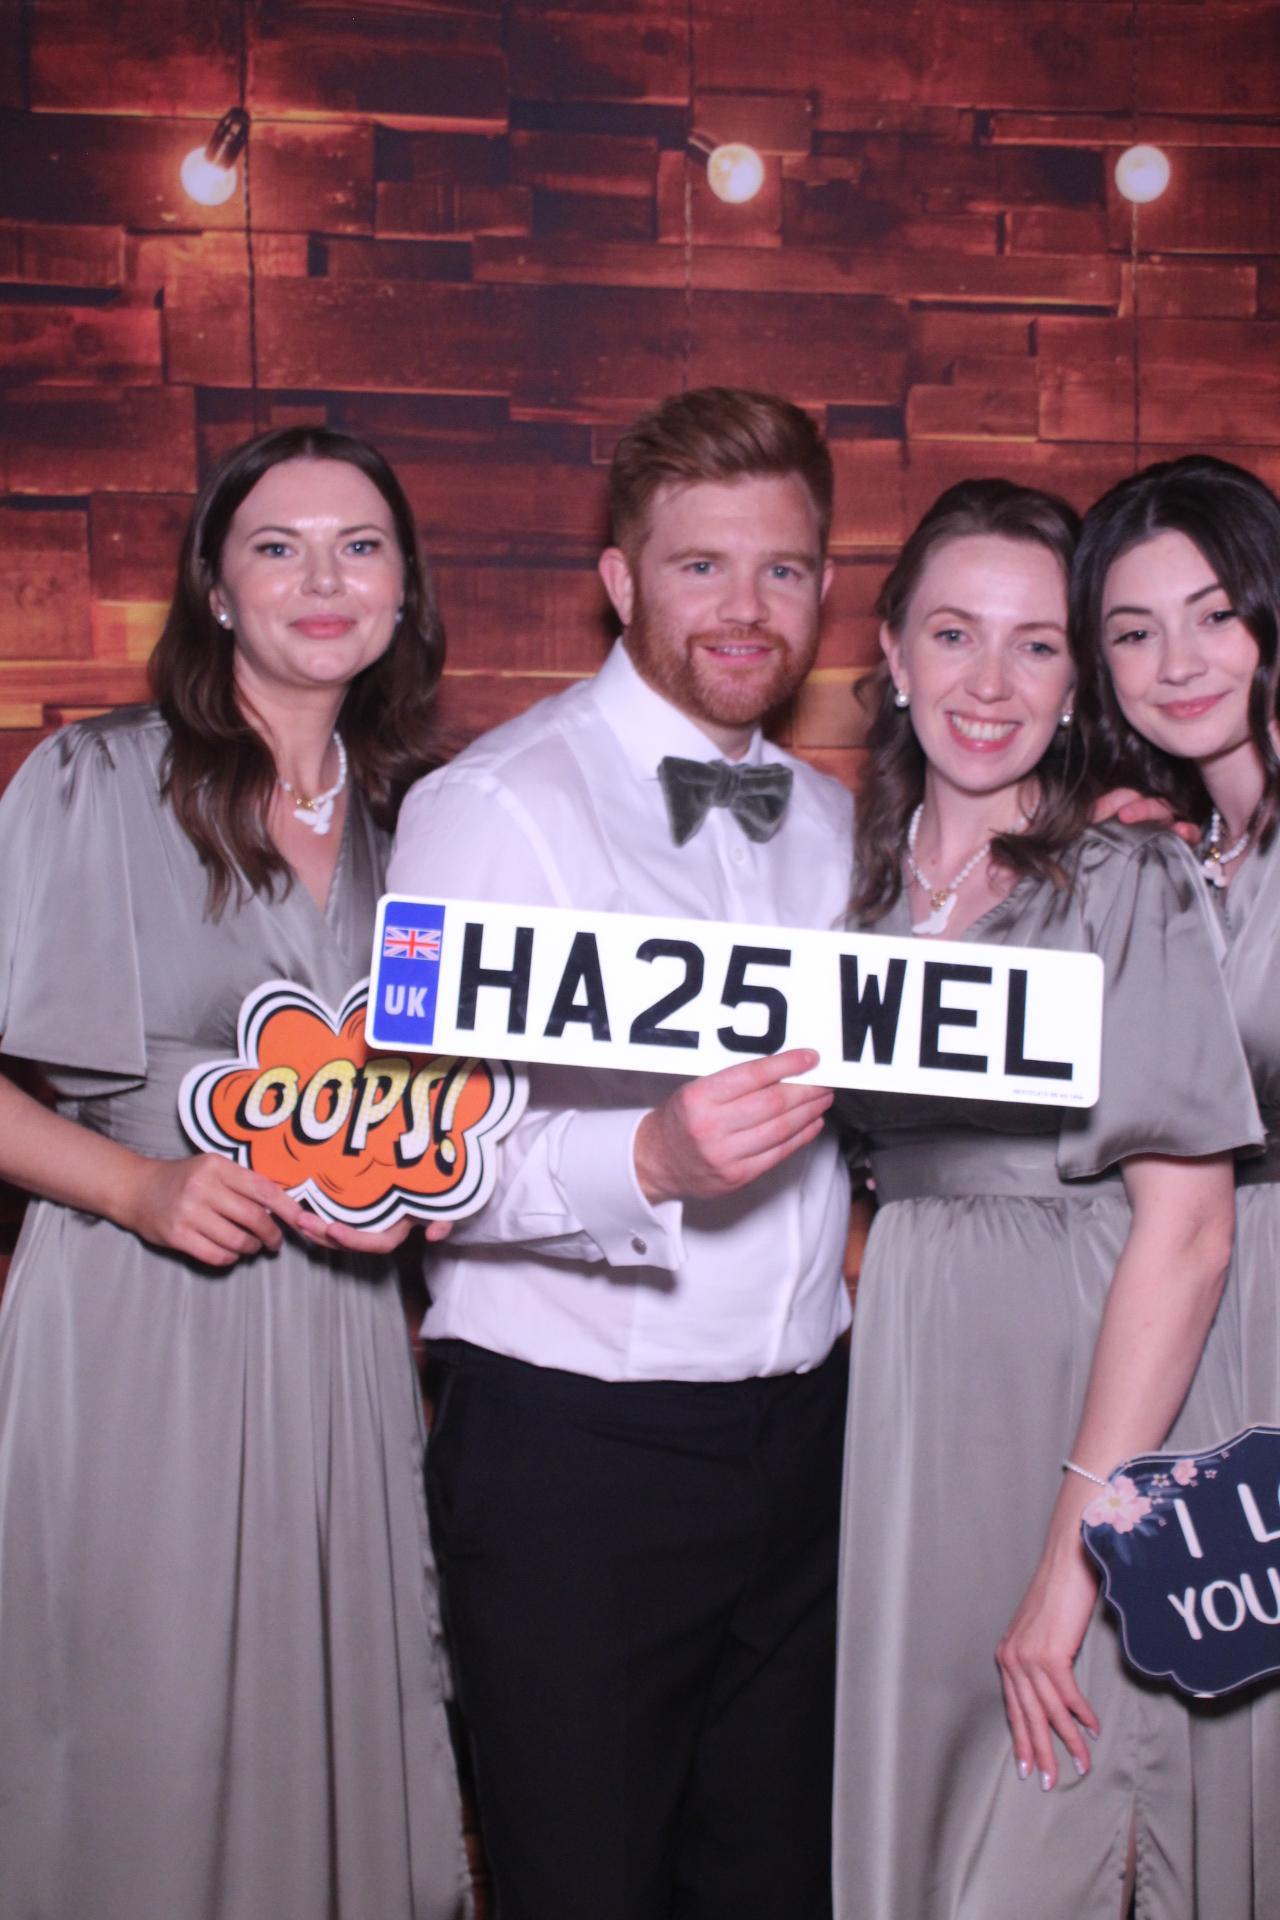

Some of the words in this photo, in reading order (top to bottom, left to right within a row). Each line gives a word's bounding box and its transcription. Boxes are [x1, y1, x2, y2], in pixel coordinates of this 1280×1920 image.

[384, 983, 429, 1018] UK
[455, 921, 792, 1056] HA25
[838, 953, 1074, 1082] WEL
[236, 1056, 482, 1176] OOPS!
[1172, 1497, 1204, 1559] I
[1237, 1482, 1280, 1543] L
[1167, 1566, 1280, 1640] YOU
